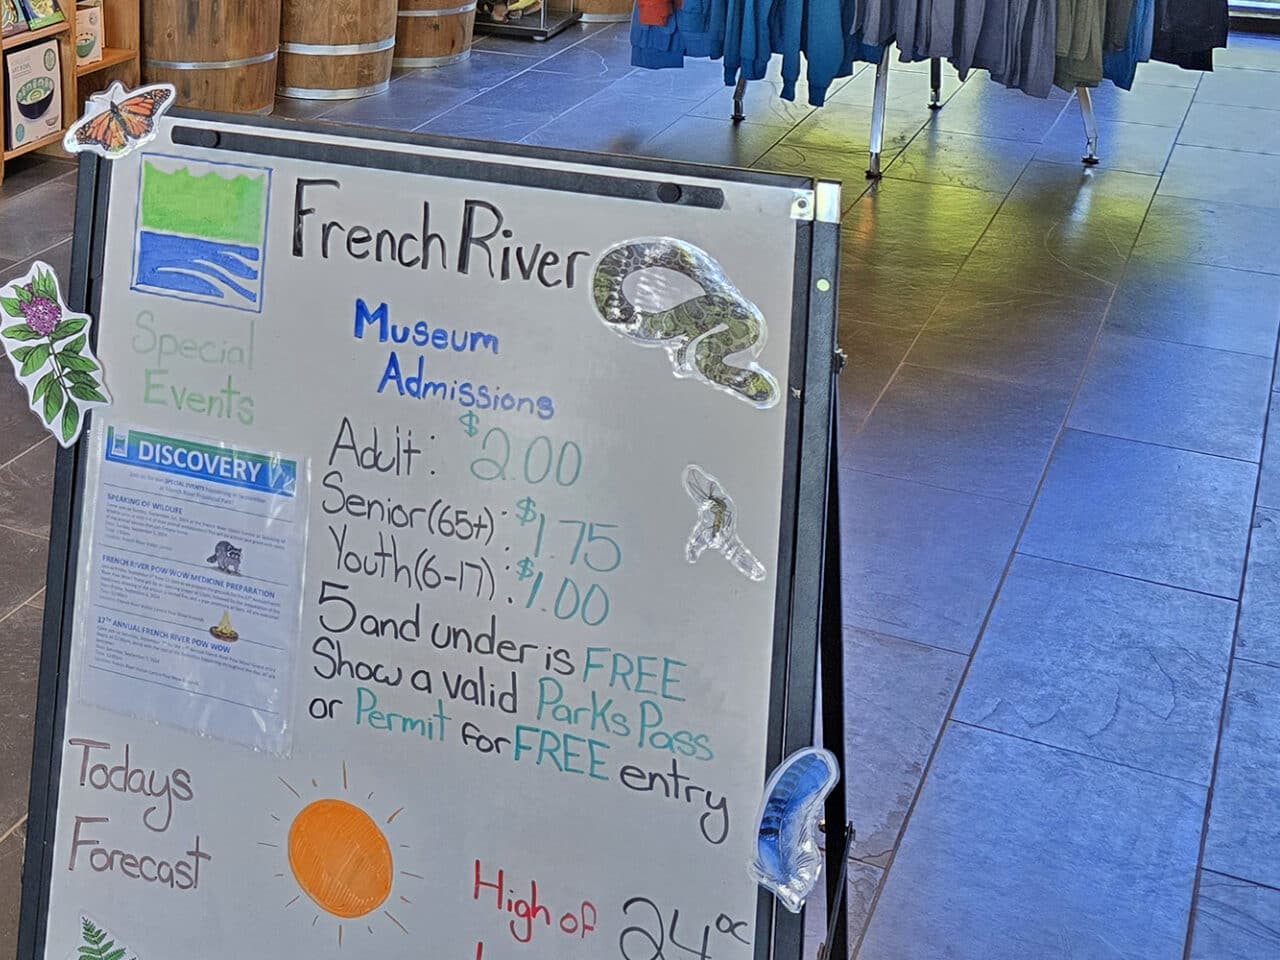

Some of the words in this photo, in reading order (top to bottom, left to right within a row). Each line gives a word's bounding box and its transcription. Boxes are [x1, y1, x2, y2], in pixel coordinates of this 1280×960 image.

[290, 177, 450, 271] French
[457, 198, 591, 290] River
[131, 310, 254, 369] Special
[353, 299, 499, 355] Museum
[145, 369, 254, 424] Events
[377, 351, 554, 421] Admissions
[138, 440, 262, 482] DISCOVERY
[107, 492, 139, 507] SPEAKING
[140, 500, 151, 509] OF
[152, 502, 183, 516] WILDLIFE
[102, 554, 129, 567] FRENCH
[130, 559, 150, 573] RIVER
[151, 564, 170, 576] POW
[170, 567, 192, 581] WOW
[191, 573, 225, 589] MEDICINE
[226, 580, 276, 599] PREPARATION
[113, 620, 141, 635] ANNUAL
[142, 626, 170, 640] FRENCH
[170, 632, 191, 645] RIVER
[191, 637, 210, 650] POW
[211, 642, 232, 654] WOW
[318, 582, 356, 634] 5
[360, 604, 421, 644] and
[431, 616, 538, 664] under
[545, 645, 575, 675] is
[583, 647, 687, 704] FREE
[312, 636, 402, 687] Show
[410, 669, 432, 693] a
[443, 665, 519, 714] valid
[638, 702, 713, 761] Pass
[68, 737, 193, 833] Todays
[308, 696, 343, 721] or
[356, 687, 452, 742] Permit
[461, 722, 511, 756] for
[513, 725, 610, 781] FREE
[620, 757, 730, 844] entry
[68, 815, 211, 890] Forecast
[474, 858, 550, 944] High
[560, 902, 596, 938] of
